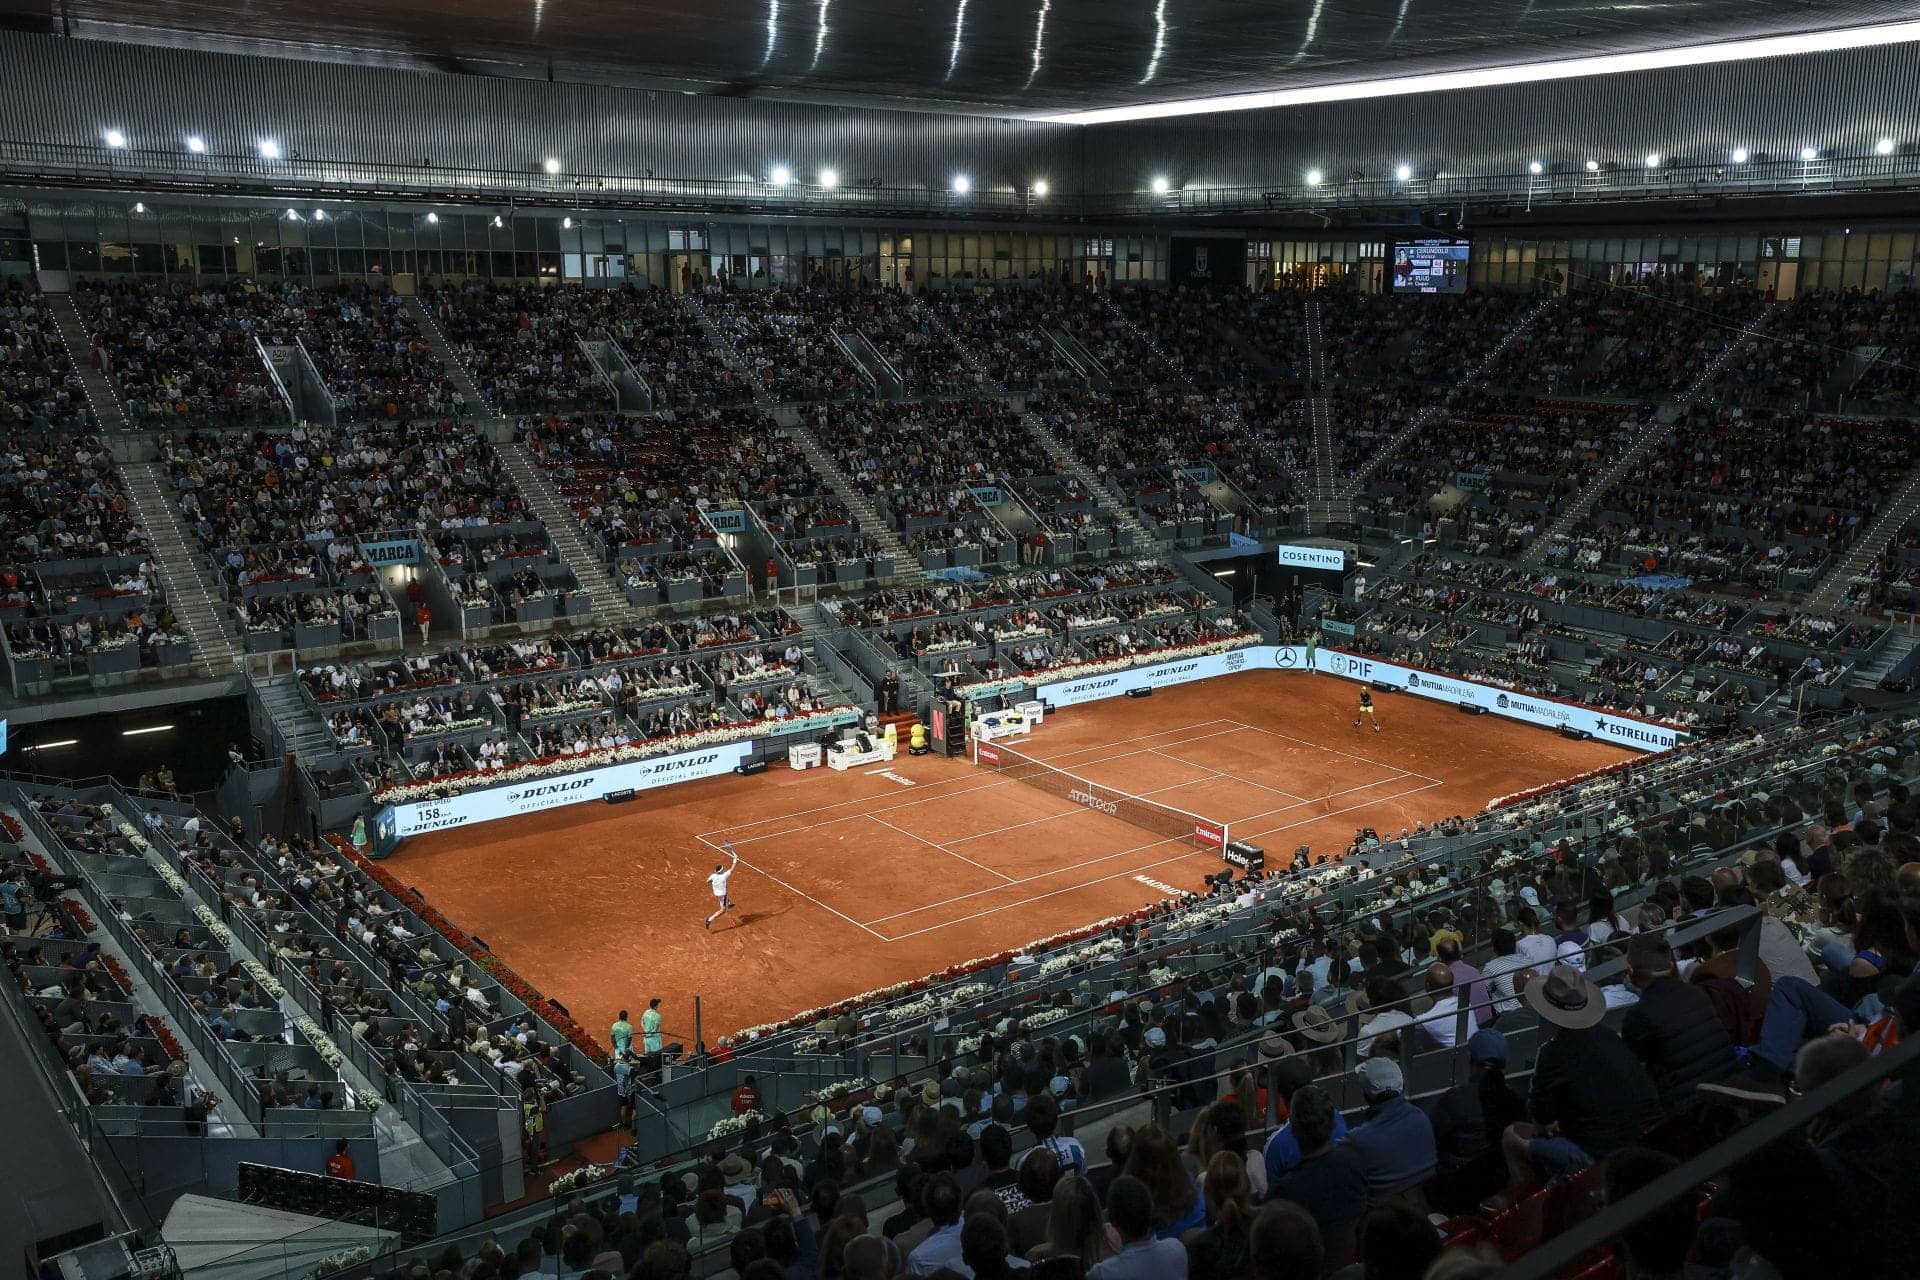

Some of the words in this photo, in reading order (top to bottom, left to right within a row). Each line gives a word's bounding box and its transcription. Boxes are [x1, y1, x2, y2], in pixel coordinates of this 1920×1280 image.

[366, 545, 413, 561] MARCA
[1282, 551, 1341, 564] COSENTINO
[1155, 663, 1198, 677] DUNLOP
[1348, 659, 1373, 677] PIF
[1072, 678, 1119, 693] DUNLOP
[1610, 724, 1658, 743] ESTRELLA
[653, 753, 718, 774] DUNLOP
[522, 777, 594, 799] DUNLOP
[418, 808, 440, 821] 158
[413, 815, 468, 832] DUNLOP
